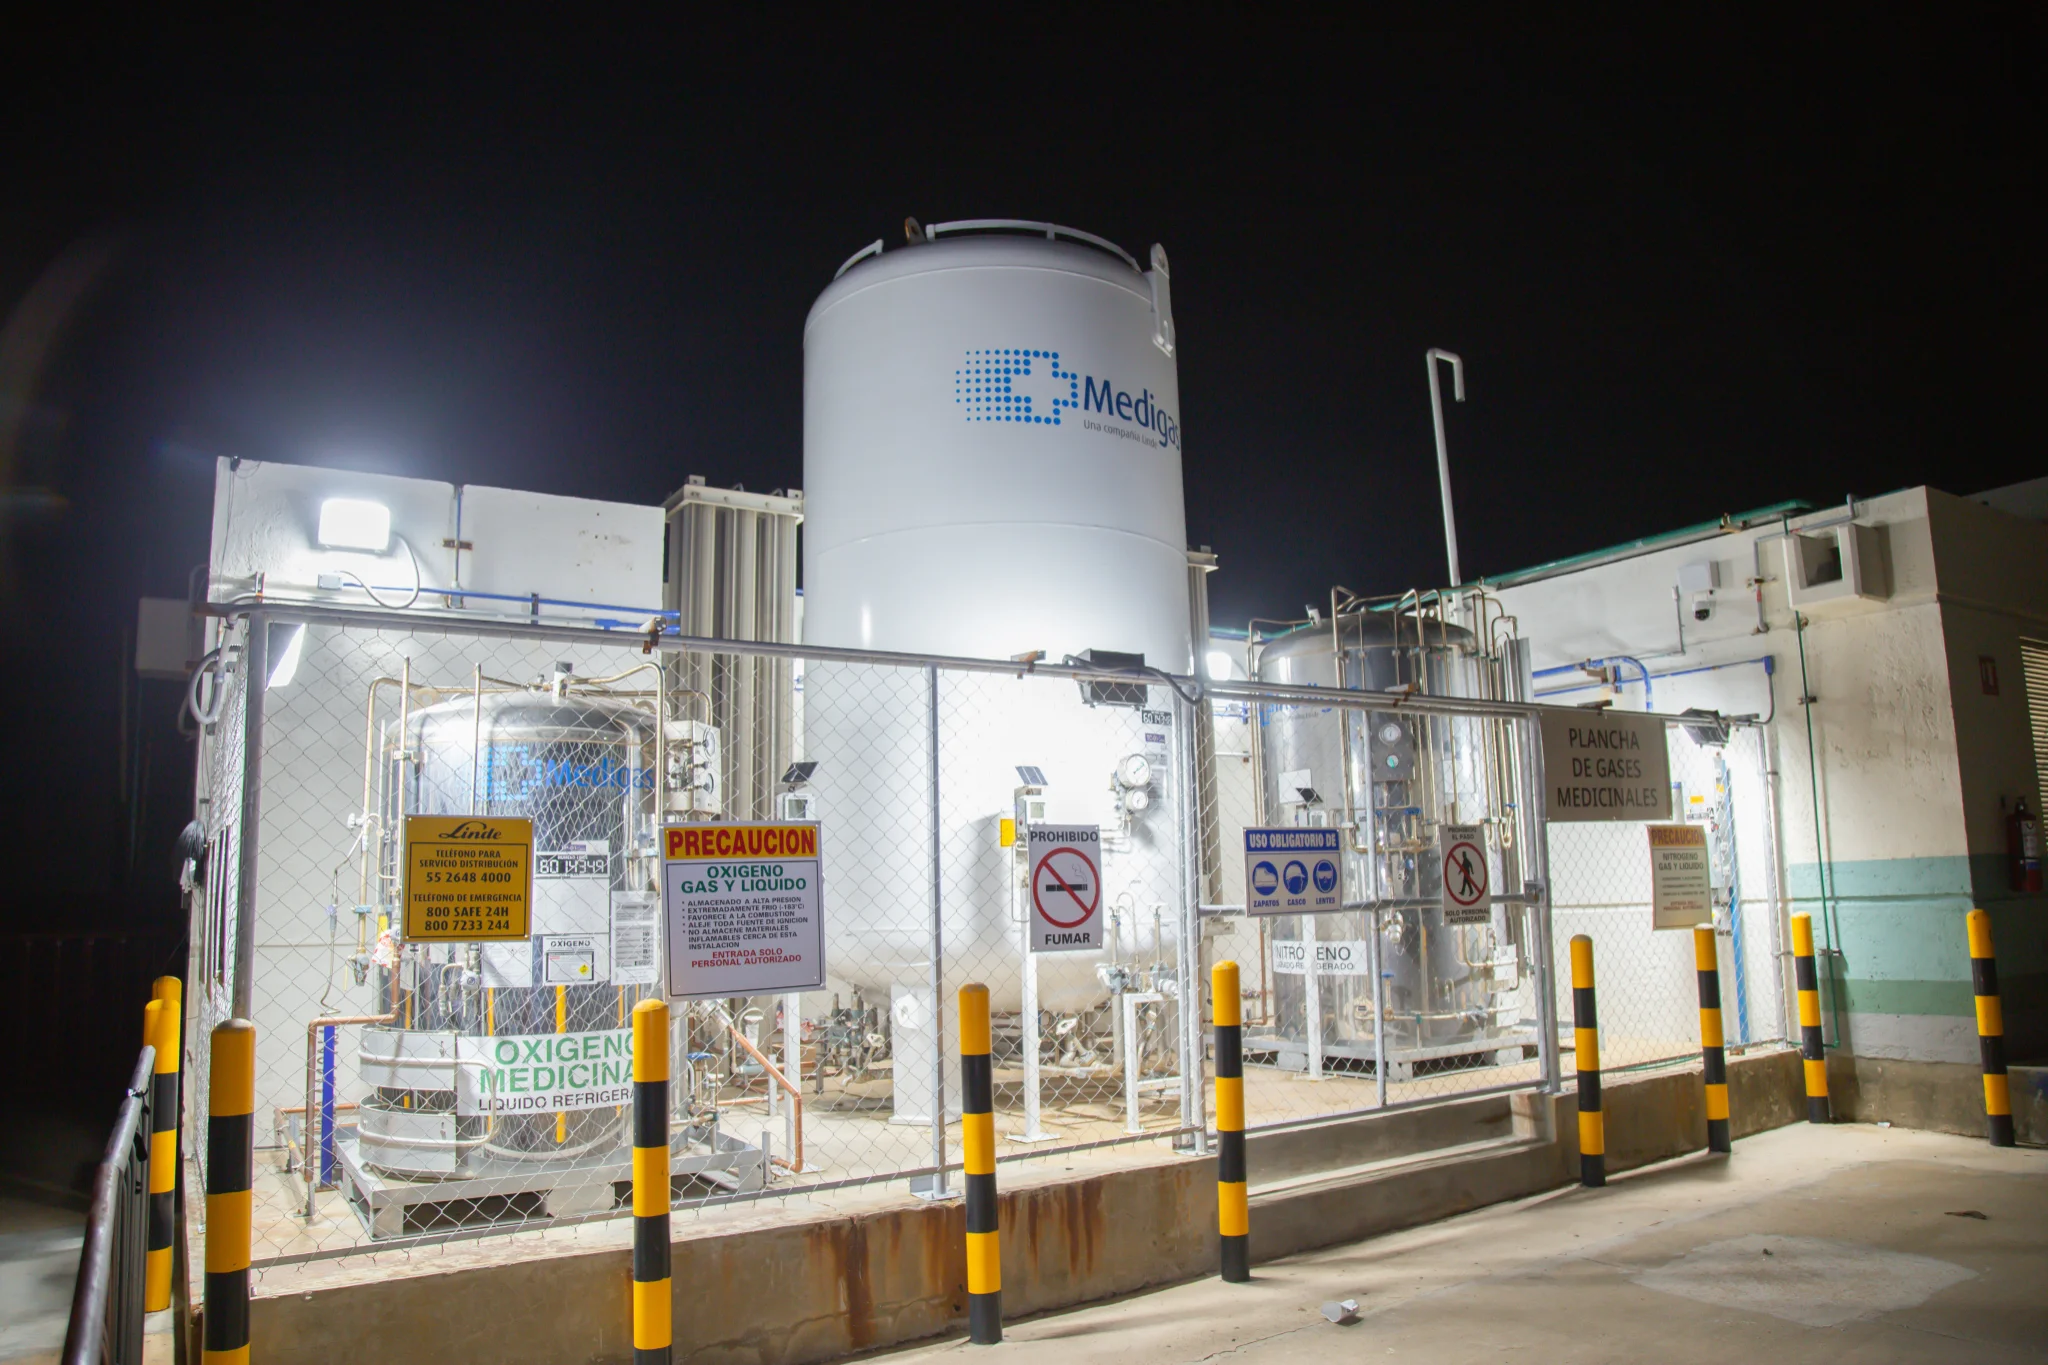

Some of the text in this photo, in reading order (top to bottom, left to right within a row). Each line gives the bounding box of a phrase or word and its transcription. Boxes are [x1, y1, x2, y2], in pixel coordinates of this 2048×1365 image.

[1084, 375, 1180, 452] Medigas
[1083, 419, 1101, 431] Una
[1568, 727, 1640, 750] PLANCHA
[1572, 757, 1642, 778] DE GASES
[546, 757, 654, 795] Medigas
[1557, 787, 1658, 808] MEDICINALES
[438, 820, 502, 840] Linde
[1030, 831, 1099, 842] PROHIBIDO
[1249, 832, 1337, 848] USO OBLIGATORIO DE
[1651, 827, 1705, 845] PRECAUCION
[668, 828, 815, 857] PRECAUCION
[436, 849, 501, 858] TELÉFONO PARA
[1663, 852, 1699, 860] NITROGENO
[419, 859, 518, 868] SERVICIO DISTRIBUCIÓN
[1658, 861, 1704, 871] GAS Y LIQUIDO
[707, 864, 784, 879] OXIGENO
[426, 872, 511, 883] 55 2648 4000
[681, 878, 807, 894] GAS Y LIQUIDO
[413, 893, 522, 902] TELÉFONO DE EMERGENCIA
[687, 899, 742, 907] ALMACENADO
[771, 896, 801, 904] PRESION
[1287, 898, 1307, 906] CASCO
[1316, 896, 1336, 905] LENTES
[1253, 899, 1280, 908] ZAPATOS
[426, 906, 509, 917] 800 SAFE 24H
[687, 905, 760, 914] EXTREMADAMENTE
[748, 910, 796, 919] COMBUSTION
[1444, 909, 1460, 917] SOLO
[424, 920, 510, 931] 800 7233 244
[688, 921, 712, 929] ALEJE
[1449, 916, 1486, 924] AUTORIZADO
[702, 927, 744, 935] ALMACENE
[745, 924, 789, 933] MATERIALES
[688, 934, 741, 943] INFLAMABLES
[742, 933, 767, 941] CERCA
[1045, 932, 1090, 944] FUMAR
[688, 941, 740, 950] INSTALACION
[712, 947, 783, 960] ENTRADA SOLO
[1275, 942, 1351, 961] NITRÓENO
[691, 954, 802, 968] PERSONAL AUTORIZADO
